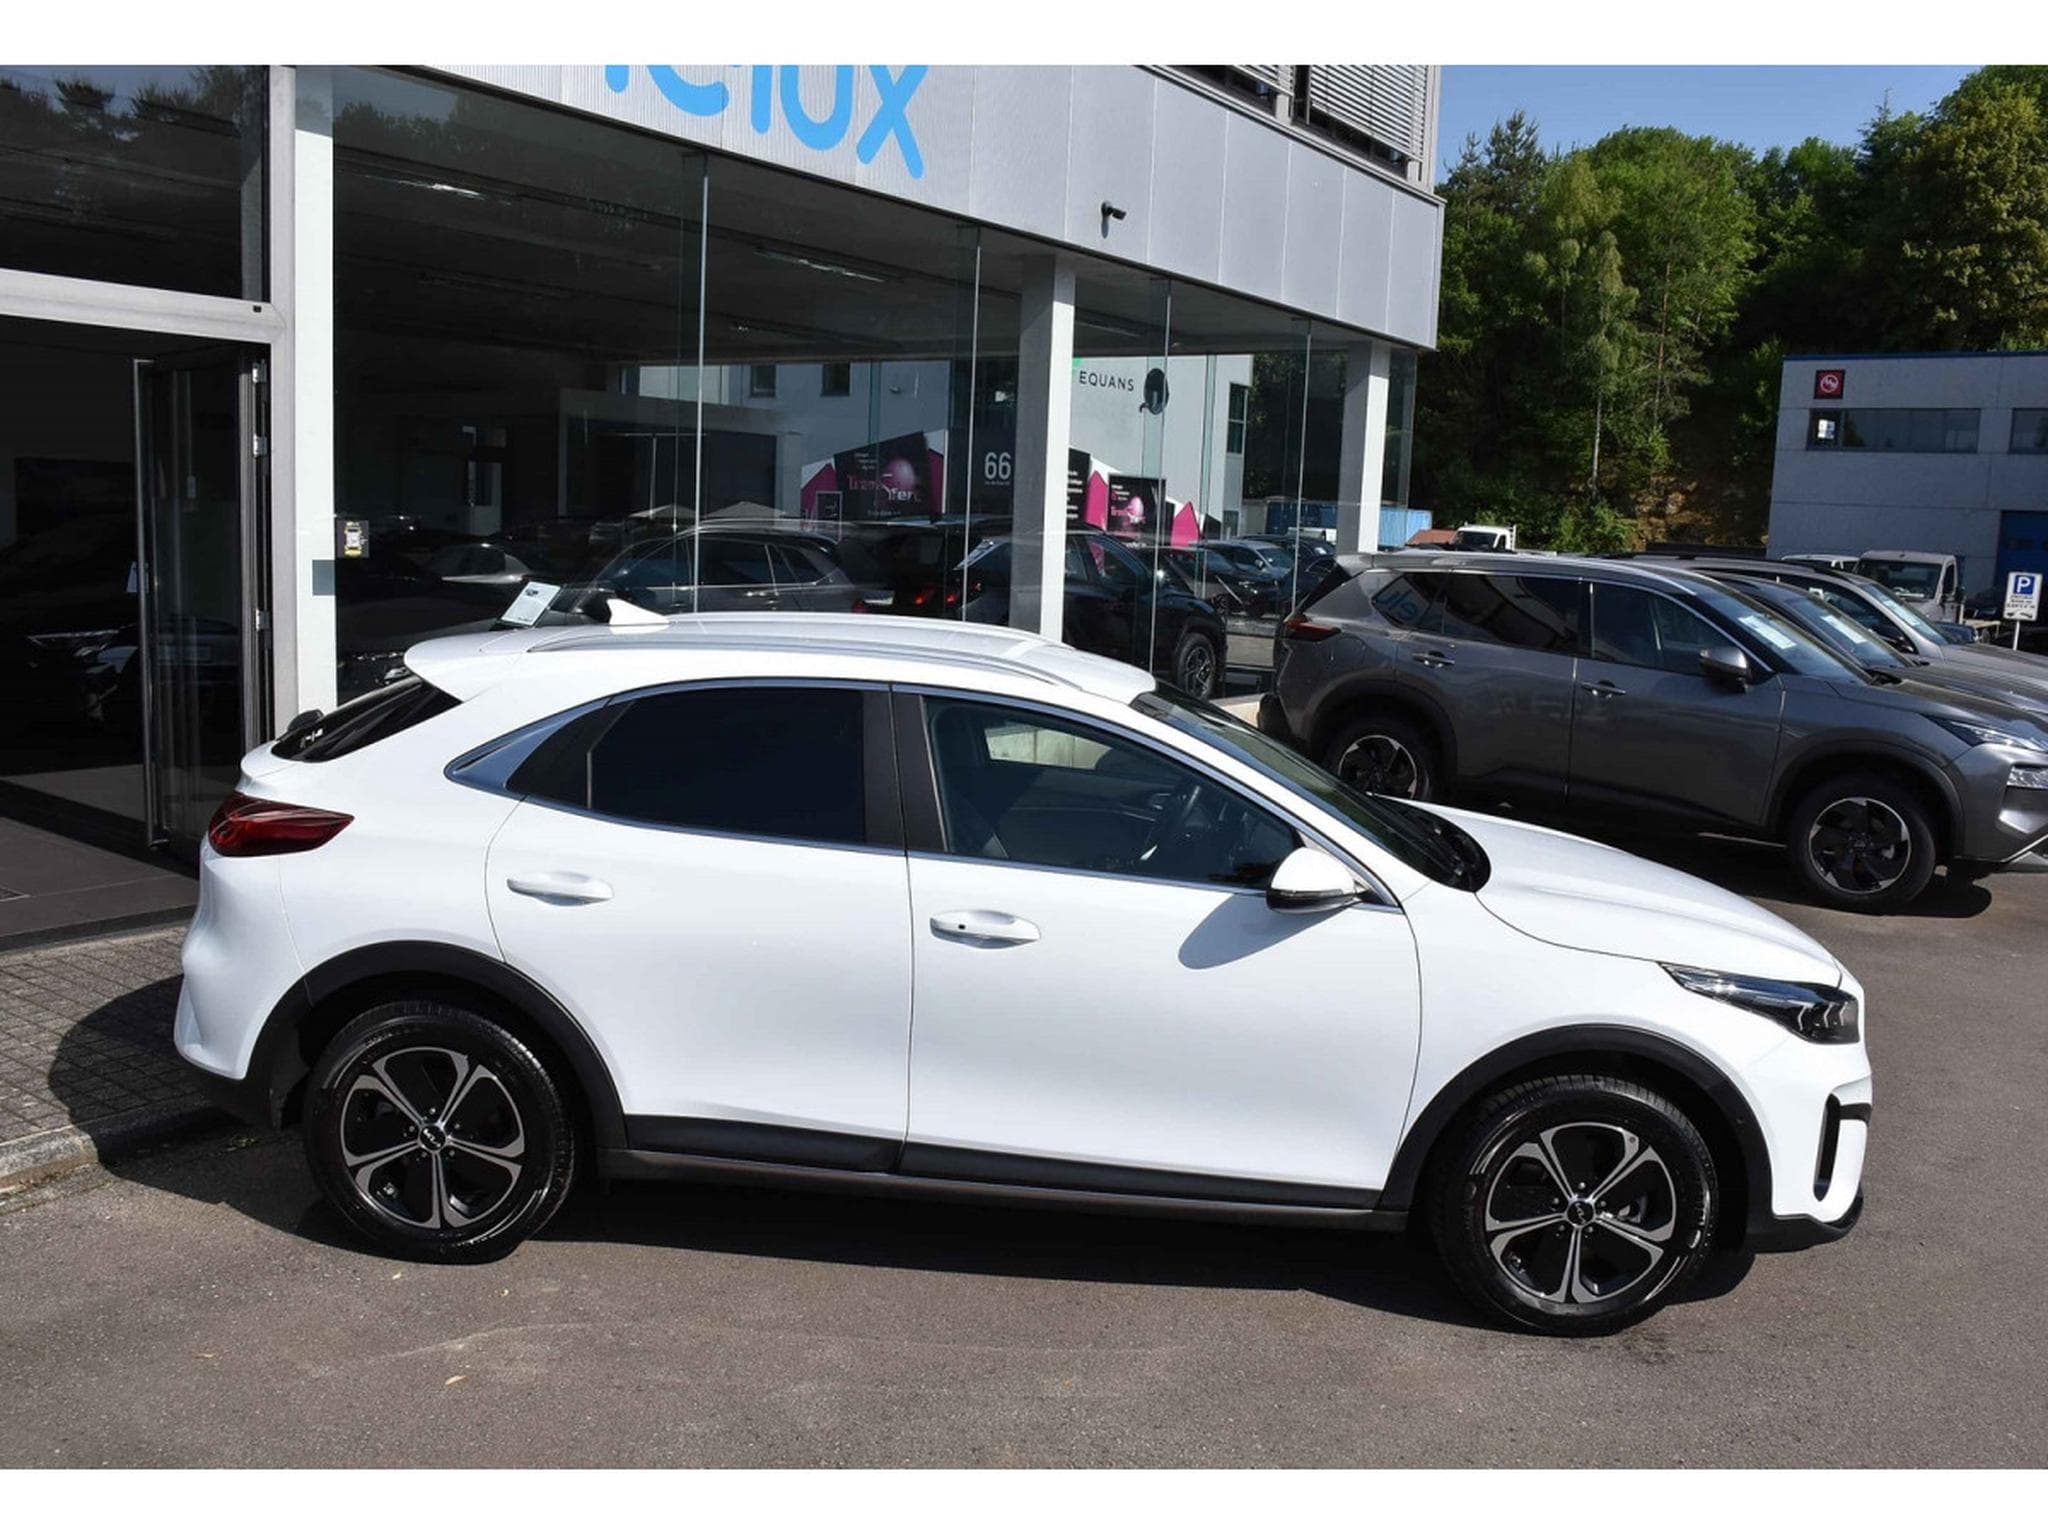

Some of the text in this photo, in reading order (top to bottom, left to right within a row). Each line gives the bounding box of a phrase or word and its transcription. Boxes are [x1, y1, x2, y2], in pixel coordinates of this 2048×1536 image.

[1079, 370, 1135, 392] EQUANS
[985, 452, 1011, 480] 66
[2017, 576, 2031, 593] P
